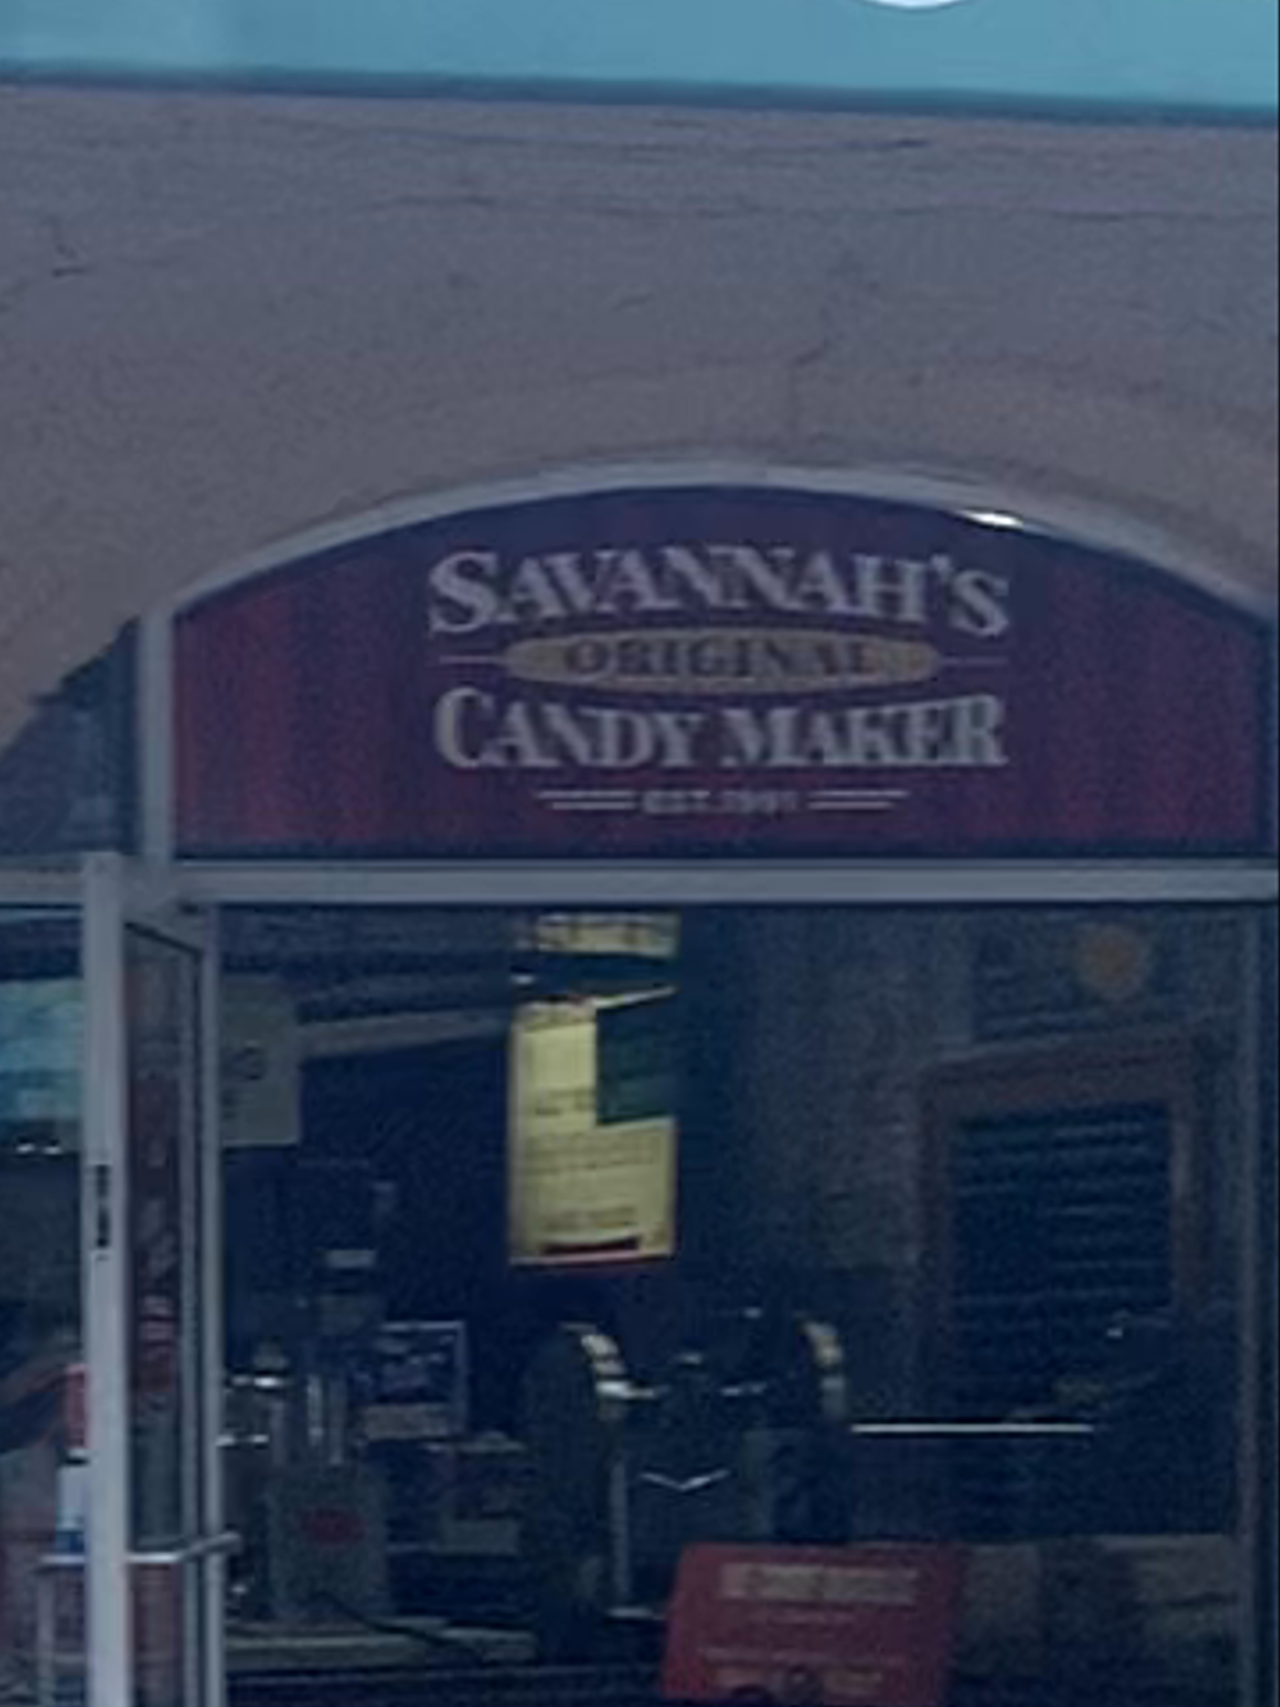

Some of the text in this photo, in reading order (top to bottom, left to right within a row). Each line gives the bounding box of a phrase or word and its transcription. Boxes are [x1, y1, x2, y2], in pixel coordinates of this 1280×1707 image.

[428, 545, 1009, 637] SAVANNAH'S
[563, 638, 870, 679] ORIGINAL
[435, 687, 1010, 768] CANDY MAKER
